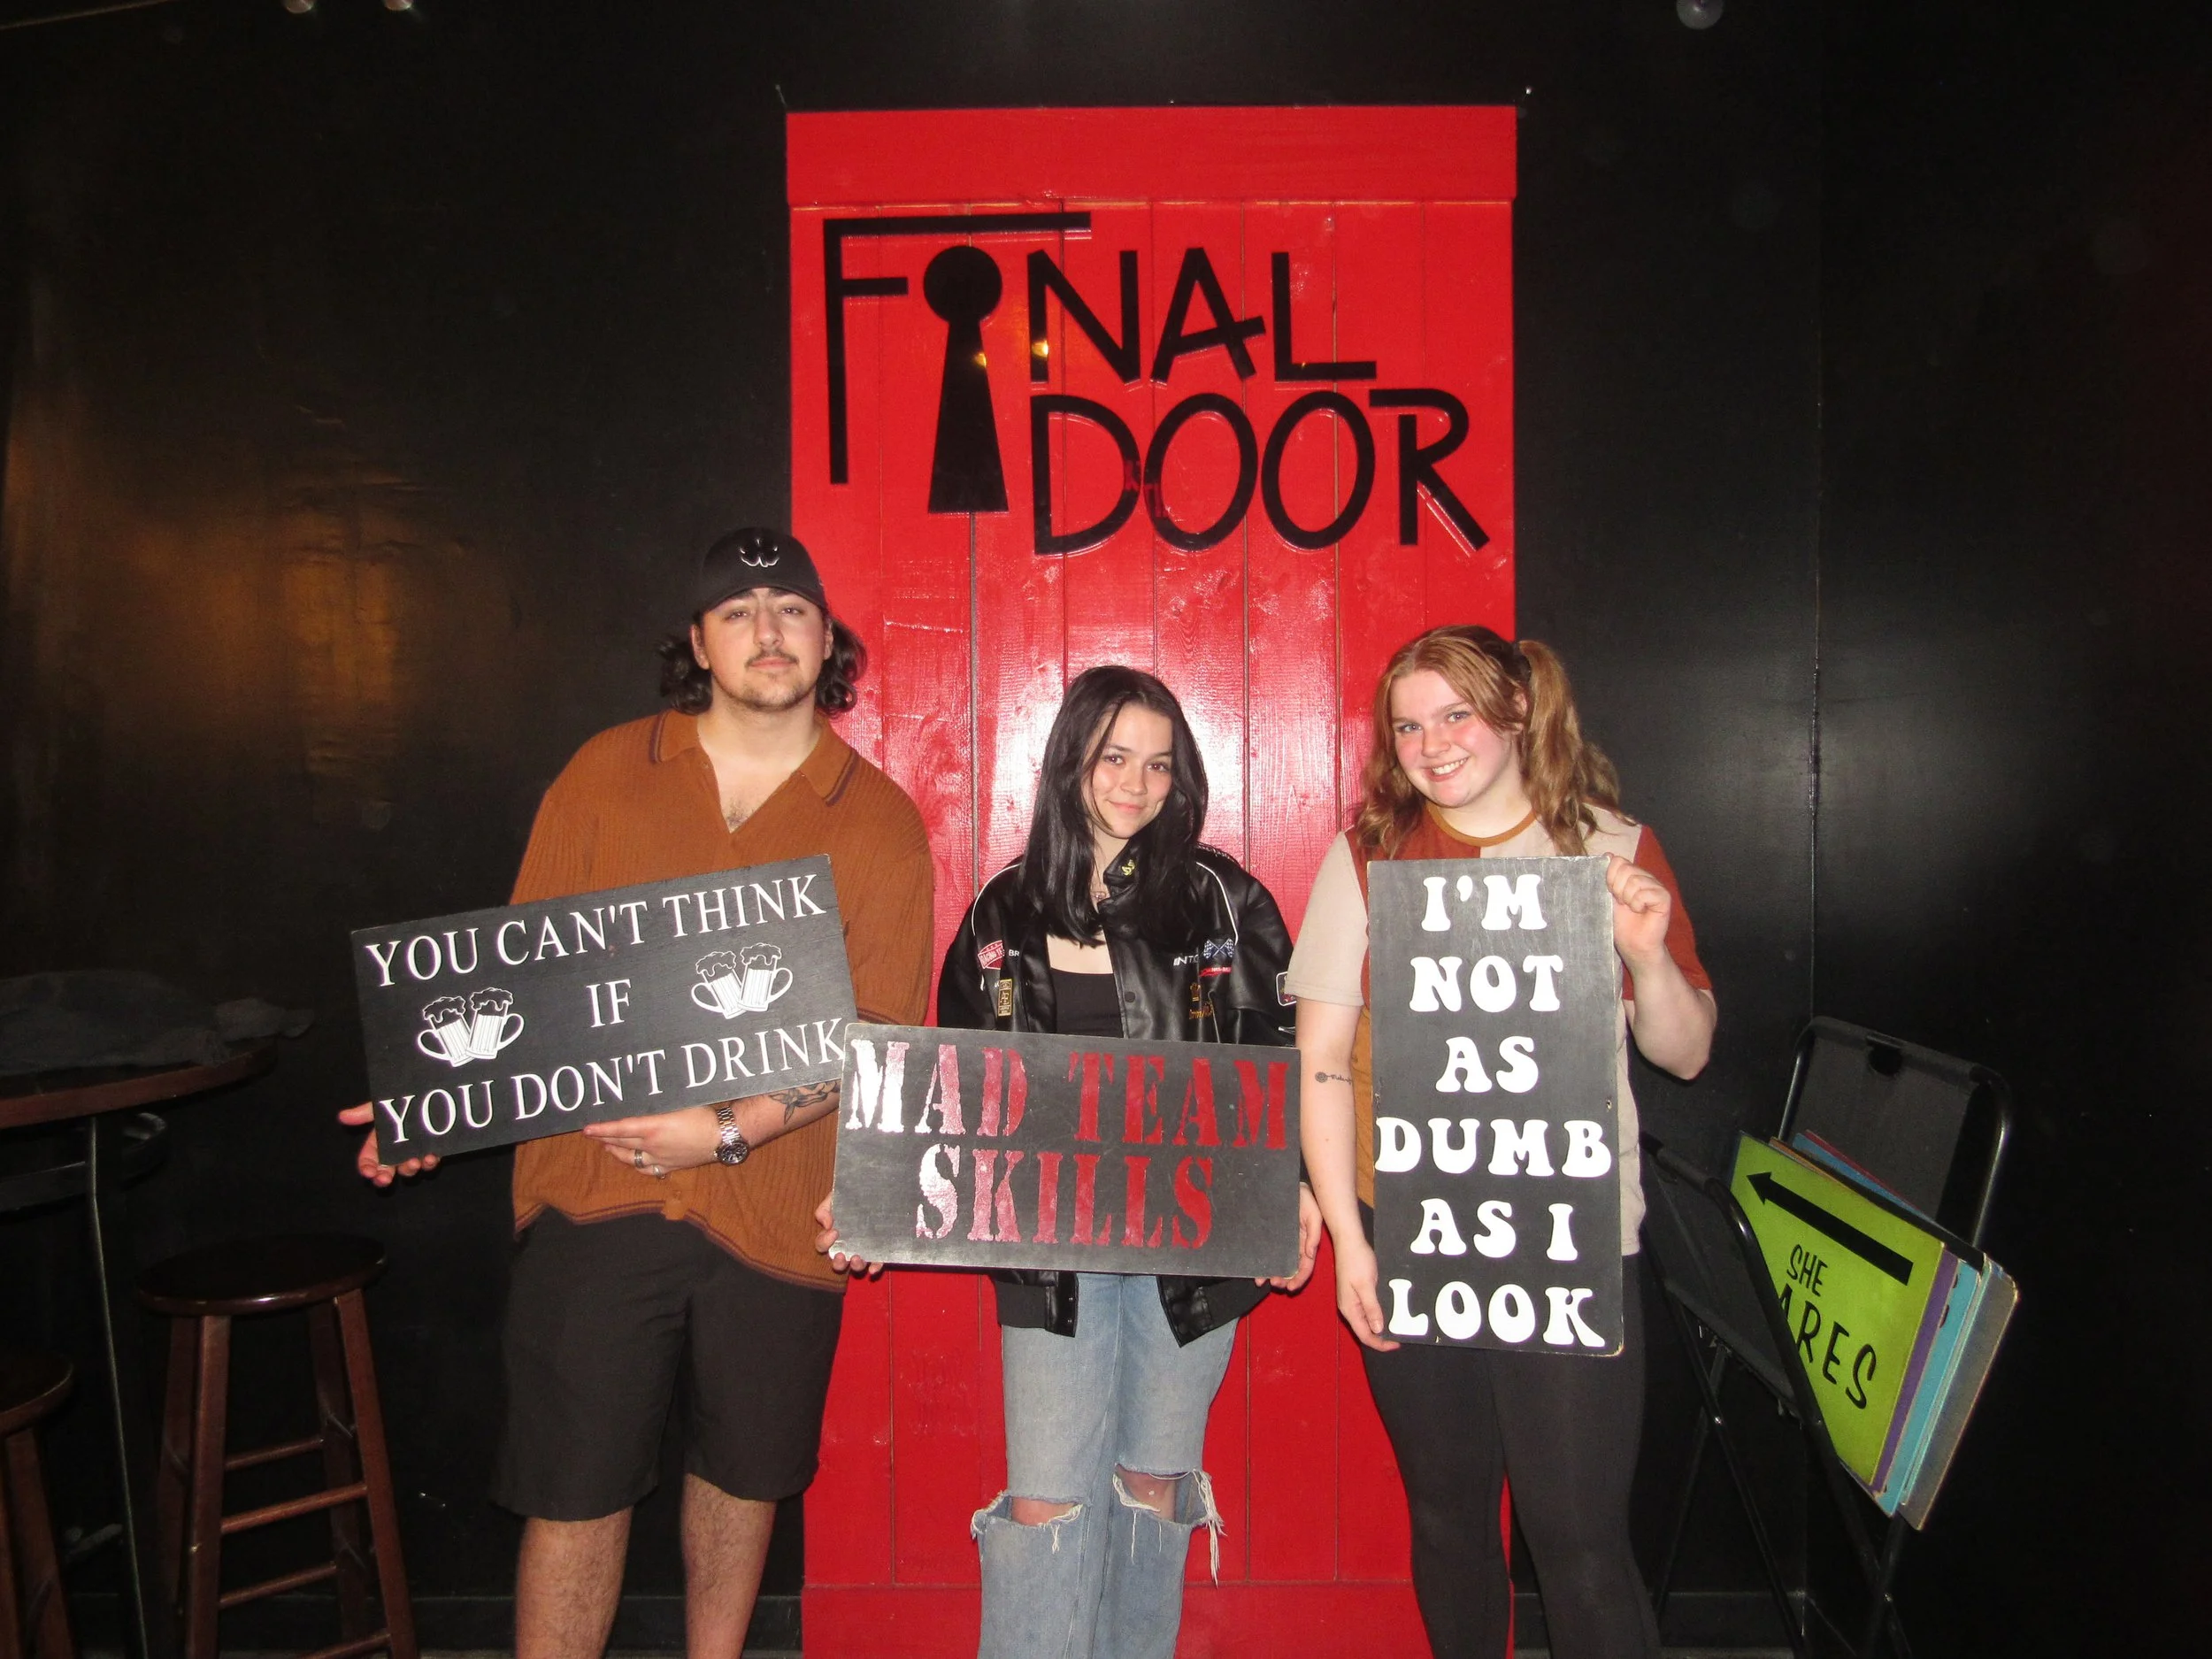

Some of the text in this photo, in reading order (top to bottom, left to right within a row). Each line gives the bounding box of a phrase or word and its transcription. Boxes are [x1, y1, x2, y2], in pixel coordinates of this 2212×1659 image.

[1031, 388, 1490, 555] DOOR
[365, 873, 826, 987] YOU CAN'T THINK
[1421, 873, 1548, 932] I'M
[586, 978, 632, 1028] IF
[1409, 954, 1564, 1013] NOT
[379, 1018, 845, 1143] YOU DON'T DRINK
[845, 1039, 1288, 1150] MAD TEAM
[1435, 1035, 1539, 1094] AS
[1375, 1117, 1612, 1178] DUMB
[915, 1143, 1214, 1249] SKILLS
[1409, 1198, 1578, 1261] AS I
[1786, 1243, 1828, 1297] SHE
[1388, 1279, 1605, 1348] LOOK
